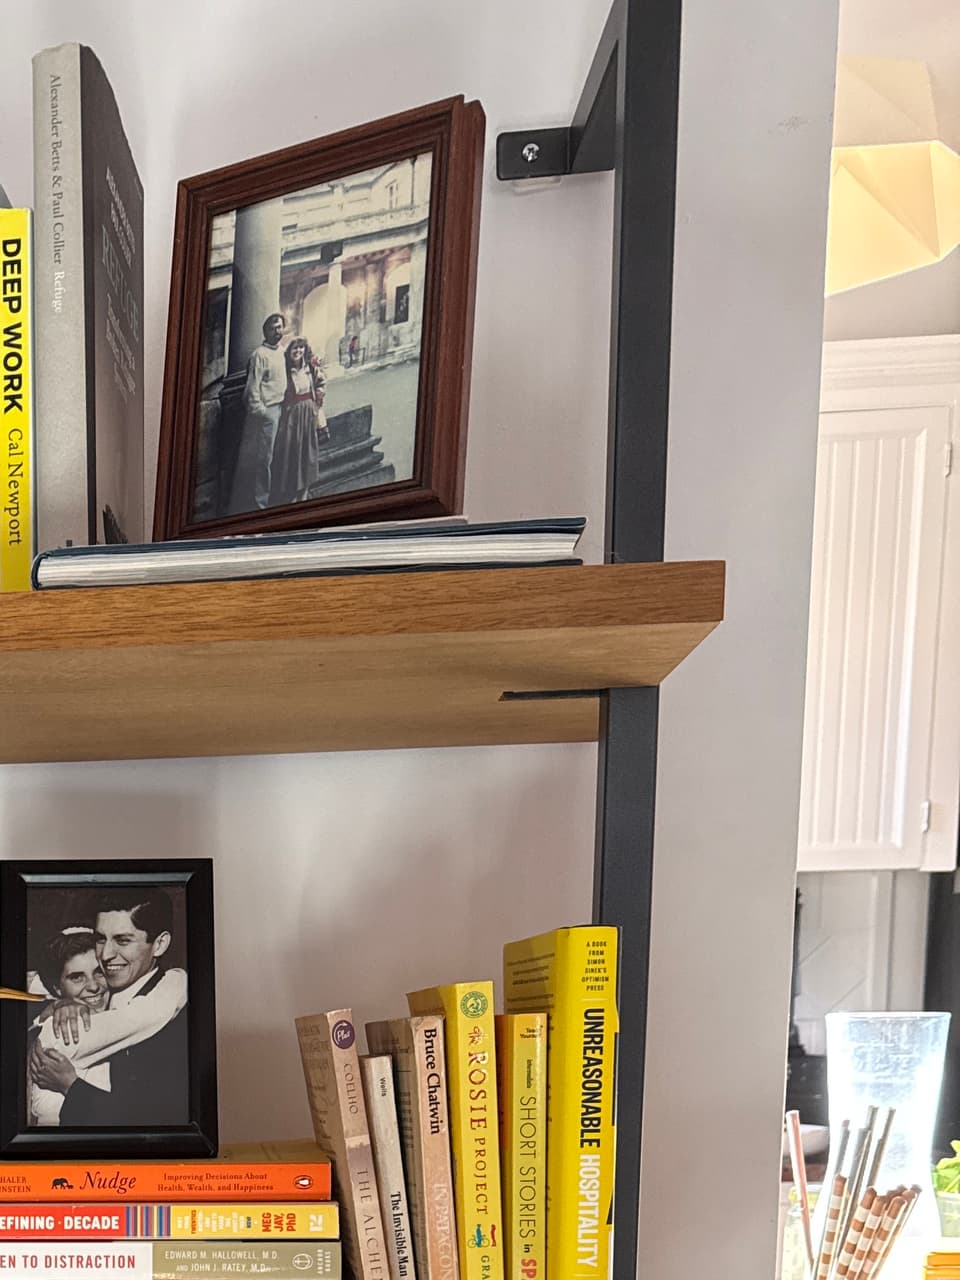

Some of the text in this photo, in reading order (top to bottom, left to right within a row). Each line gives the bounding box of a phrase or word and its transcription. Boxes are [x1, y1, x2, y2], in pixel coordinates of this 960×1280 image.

[2, 238, 23, 547] DEEP WORK Cal Newport
[424, 1028, 442, 1135] Bruce Chatwin
[579, 1007, 605, 1148] UNREASONABLE
[519, 1095, 536, 1161] SHORT
[80, 1171, 137, 1194] Nudge
[519, 1167, 537, 1239] STORIES
[578, 1154, 610, 1268] HOSPITALITY
[64, 1216, 119, 1229] DECADE
[523, 1244, 531, 1253] in
[22, 1256, 38, 1268] TO
[45, 1255, 135, 1268] DISTRACTION
